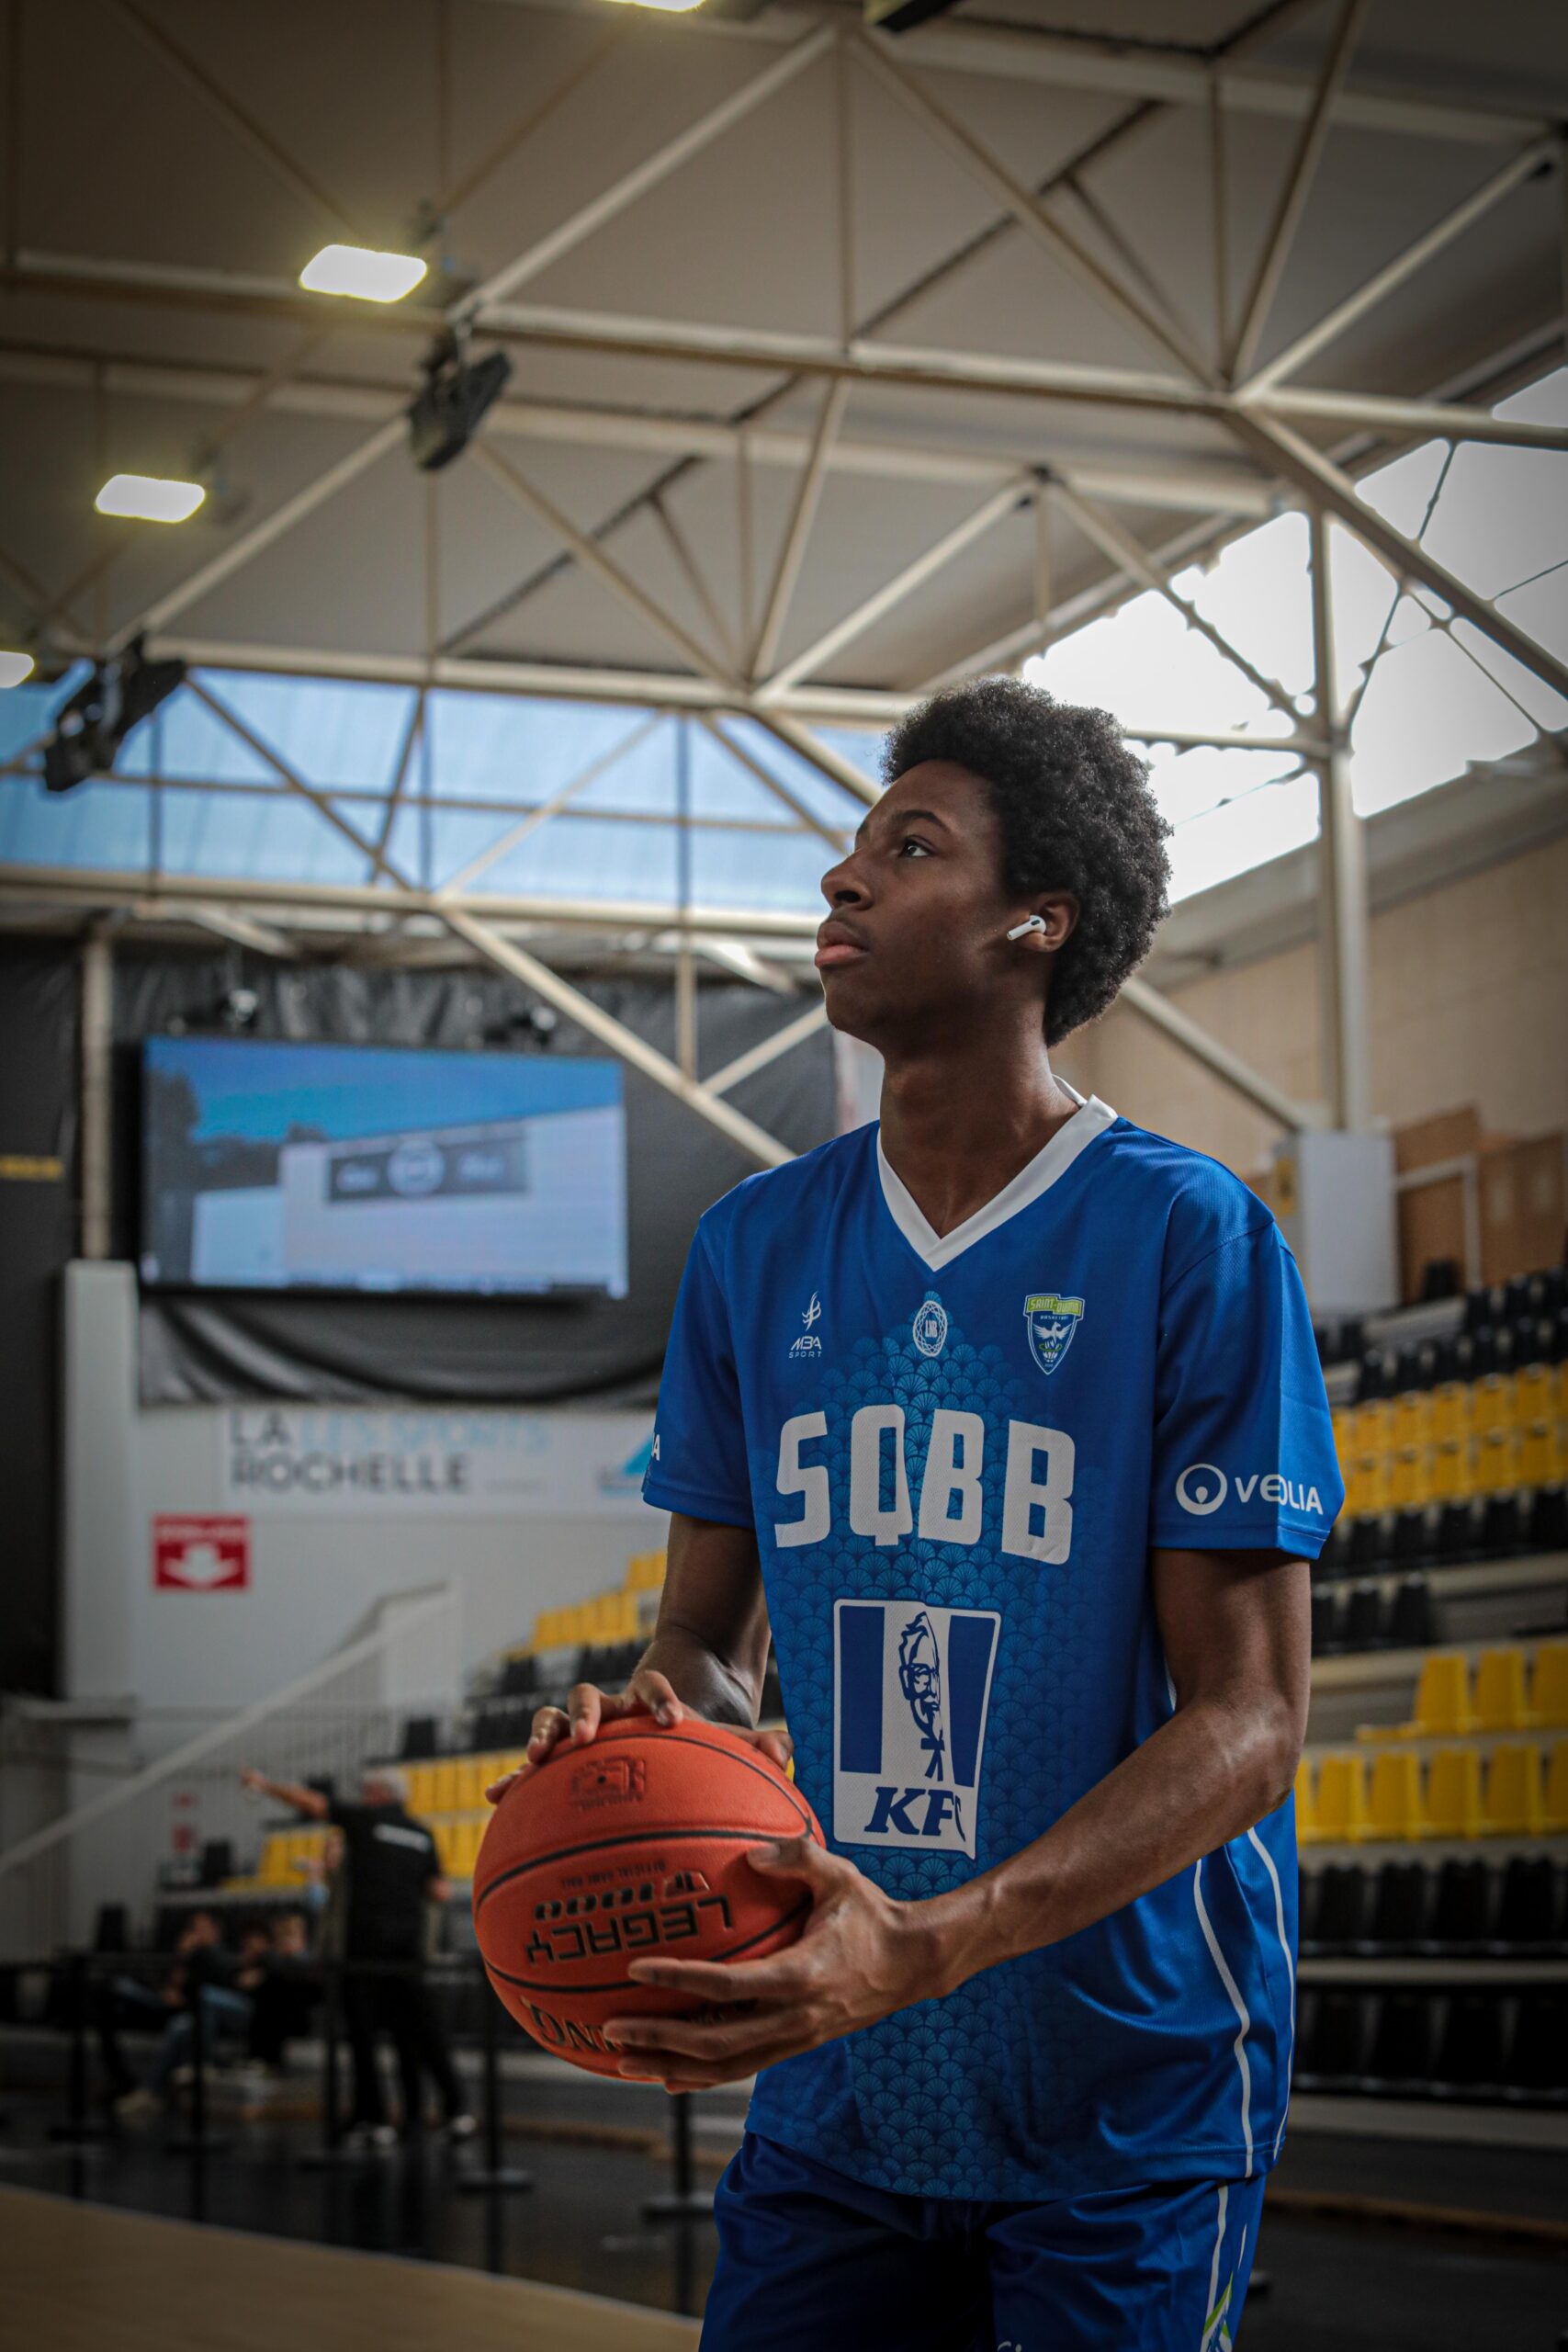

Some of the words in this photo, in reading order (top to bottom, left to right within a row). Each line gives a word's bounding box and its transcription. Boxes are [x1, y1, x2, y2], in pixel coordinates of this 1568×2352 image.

[788, 1351, 822, 1359] SPORT
[790, 1335, 822, 1351] MBA
[231, 1408, 292, 1446] LA
[231, 1451, 470, 1495] ROCHELLE
[774, 1403, 1077, 1566] SQBB
[525, 1895, 732, 1965] LEGACY
